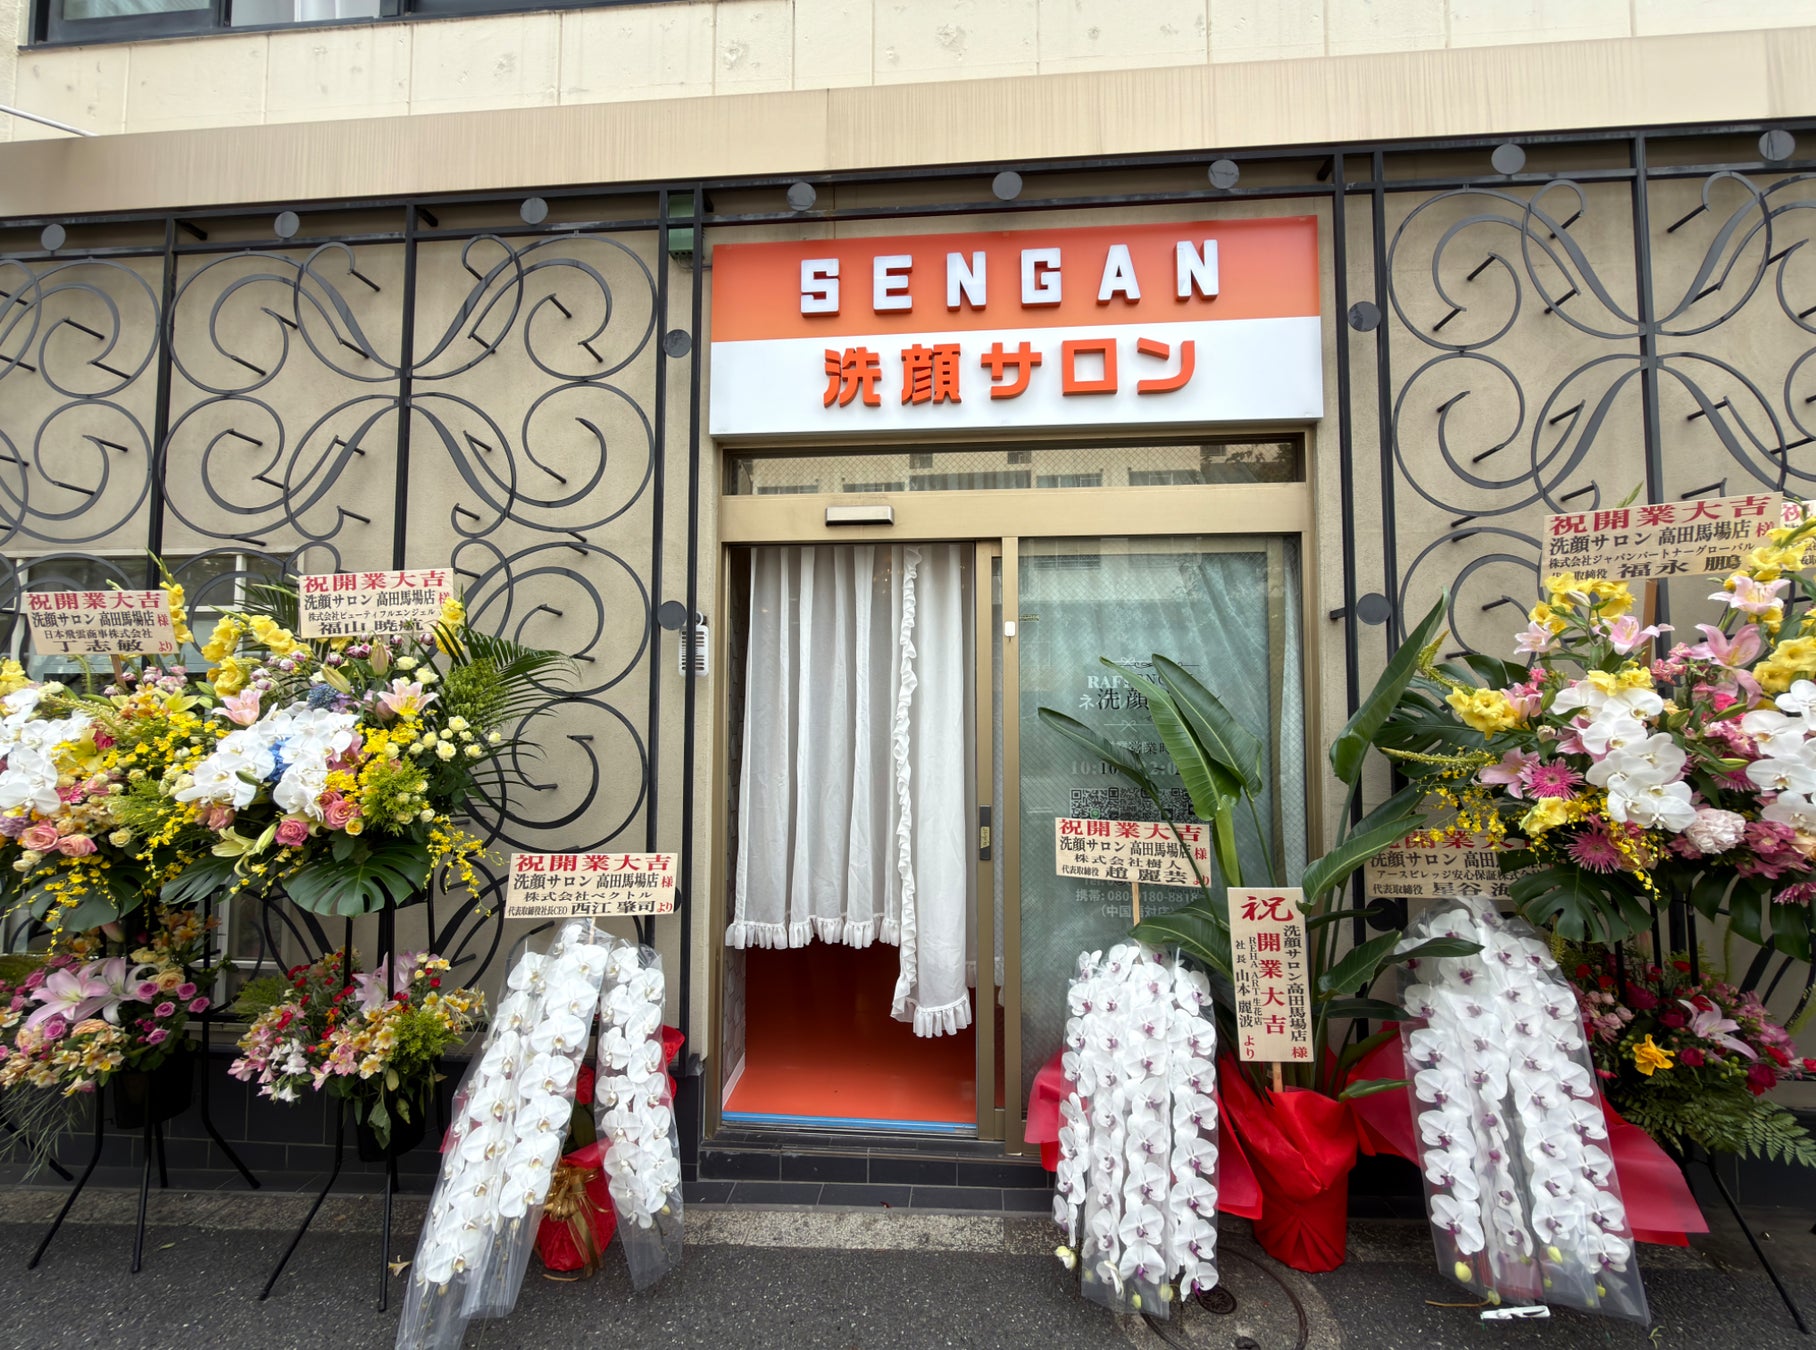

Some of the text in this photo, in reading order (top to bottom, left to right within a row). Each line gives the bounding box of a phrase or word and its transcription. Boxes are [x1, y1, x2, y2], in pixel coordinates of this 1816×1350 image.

[801, 239, 1219, 316] SENGAN
[824, 337, 1196, 408] 洗顔サロン
[1551, 496, 1772, 536] 祝開業大吉
[1550, 532, 1652, 556] 洗顔サロン
[1658, 519, 1752, 546] 高田馬場店
[1617, 559, 1688, 579] 福永
[304, 570, 446, 593] 祝開業大吉
[27, 592, 160, 610] 祝開業大吉
[304, 594, 373, 610] 洗顔サロン
[377, 589, 435, 607] 高田馬場店
[32, 611, 169, 628] 洗顔サロン 高田馬場店 様
[319, 621, 366, 634] 福山
[158, 641, 172, 652] より
[1059, 819, 1202, 843] 祝開業大吉
[1060, 836, 1207, 860] 洗顔サロン 高田馬場店 様
[515, 854, 671, 872] 祝開業大吉
[1062, 865, 1099, 876] 代表取締役
[1371, 851, 1457, 869] 洗顔サロン
[514, 873, 674, 890] 洗顔サロン 高田馬場店 様
[1373, 884, 1423, 895] 代表取締役
[524, 891, 652, 902] 株式会社ベクトル
[571, 902, 611, 915] 西江
[657, 903, 672, 912] より
[1240, 895, 1294, 922] 祝
[1235, 939, 1247, 964] 社長
[1236, 969, 1251, 996] 山本
[1257, 932, 1287, 1035] 開業大吉
[1253, 998, 1263, 1026] 生花店
[1243, 1035, 1256, 1060] より
[1291, 1046, 1308, 1059] 様
